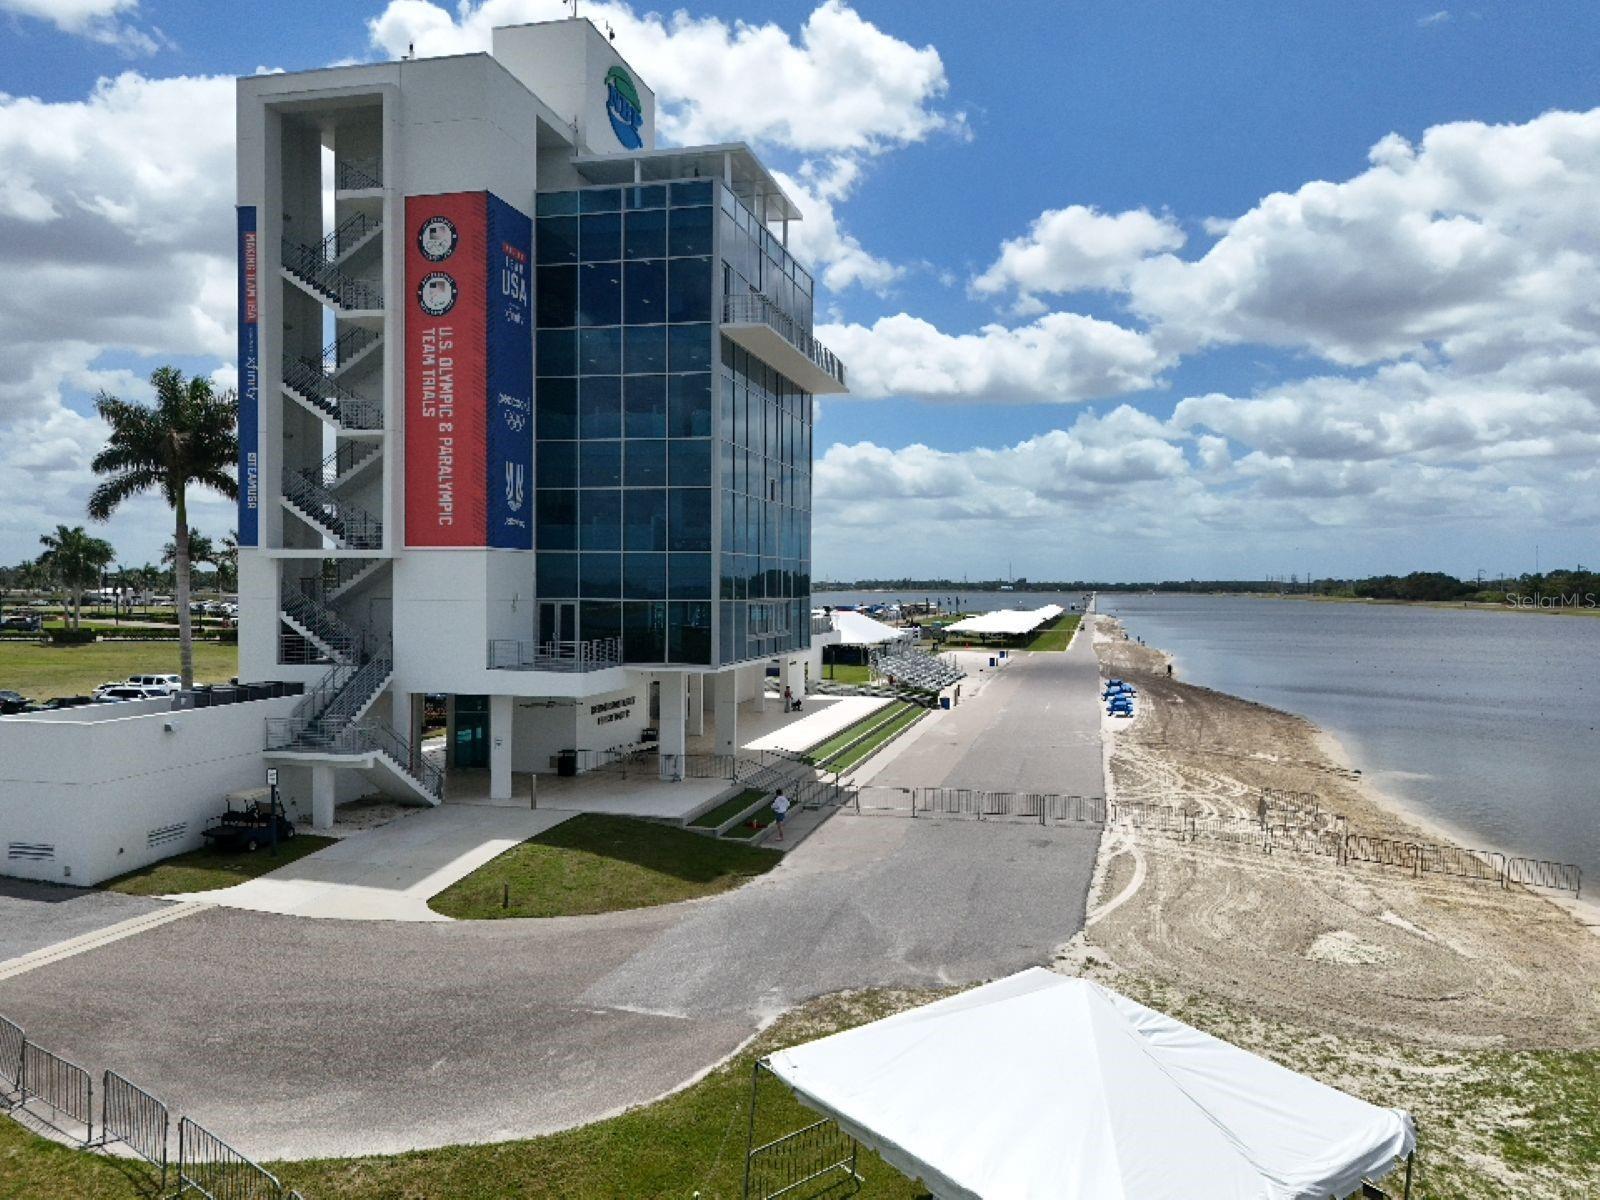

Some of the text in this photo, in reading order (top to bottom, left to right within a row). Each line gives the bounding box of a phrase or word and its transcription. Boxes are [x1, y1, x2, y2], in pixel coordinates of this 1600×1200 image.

[502, 269, 527, 308] USA
[246, 356, 258, 400] xfinity
[422, 327, 436, 417] TEAM TRIALS
[439, 327, 454, 526] U.S. OLYMPIC & PARALYMPIC
